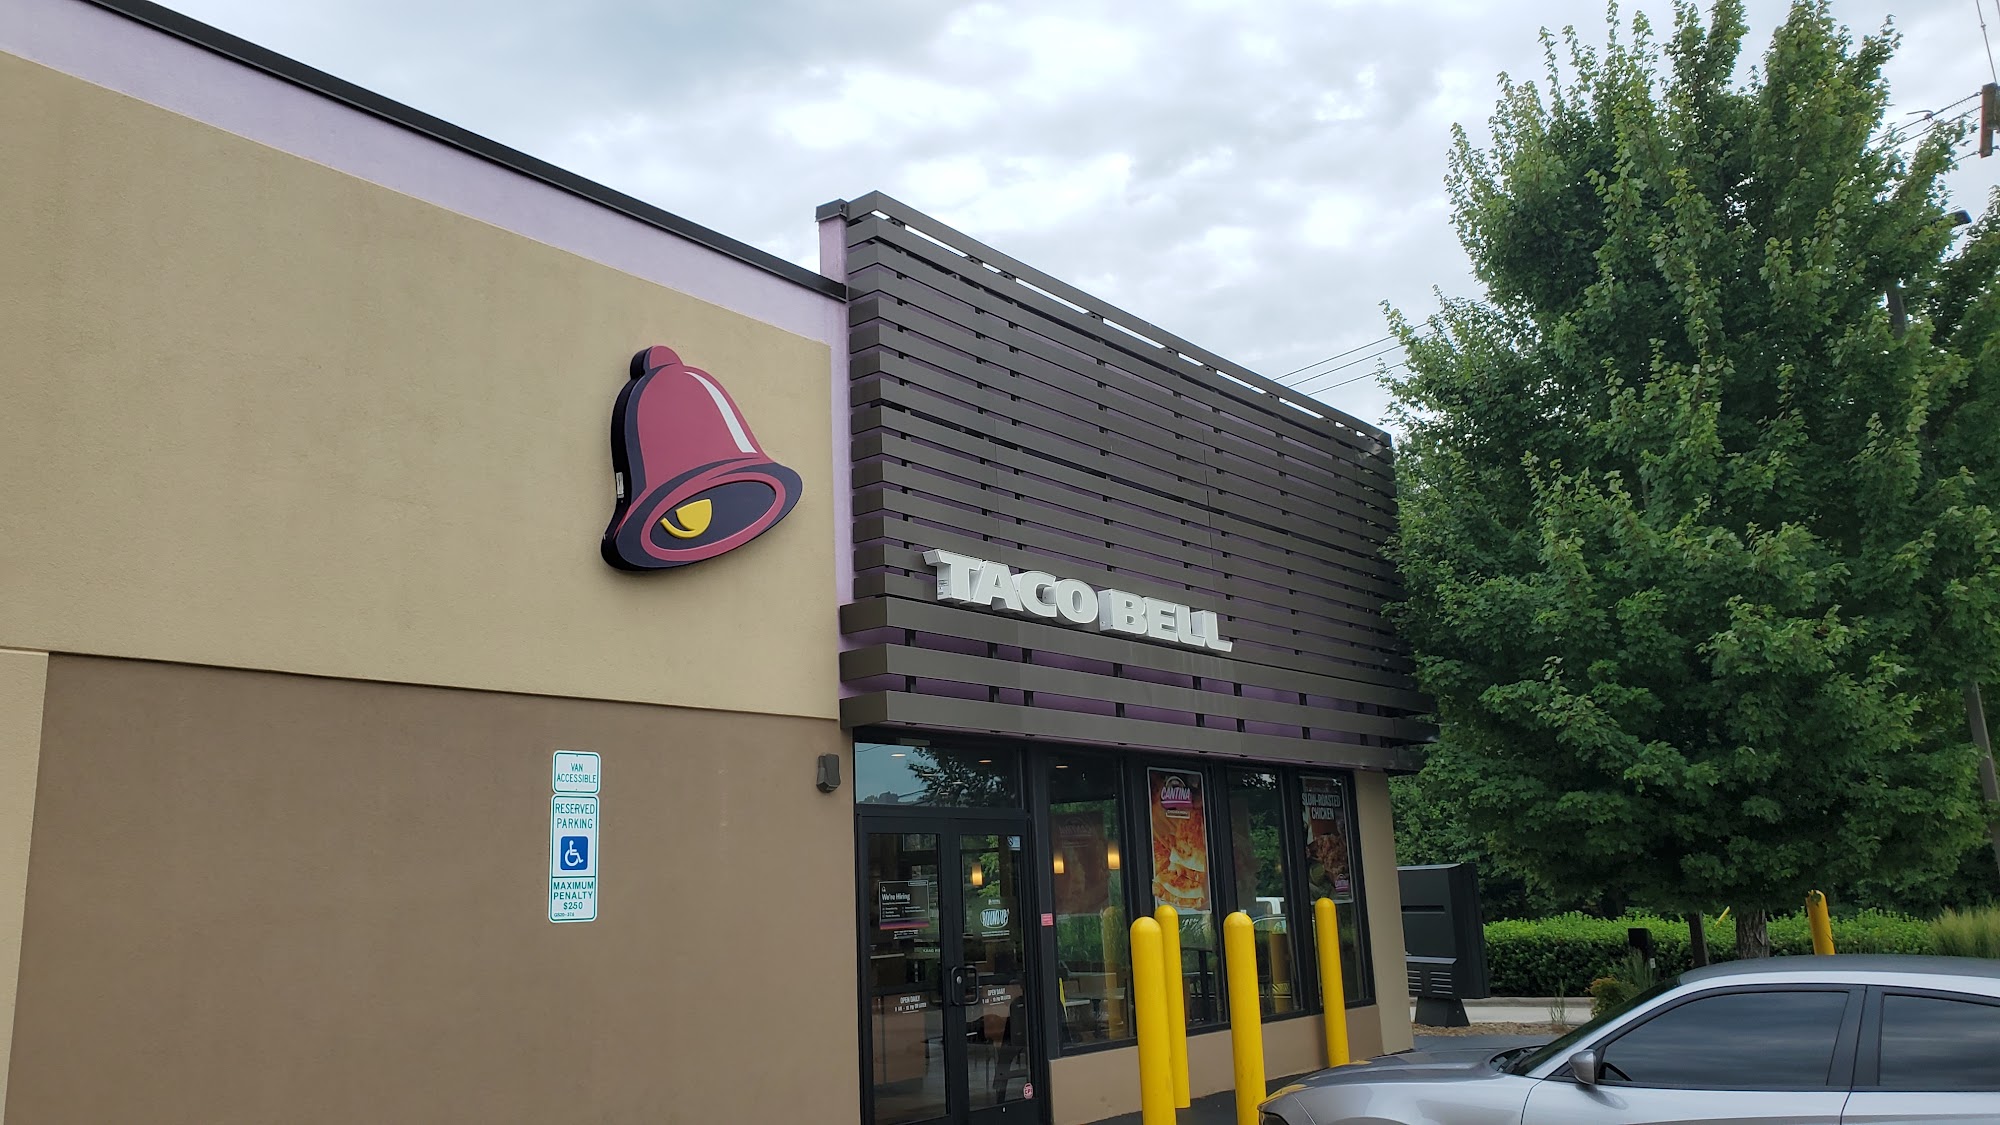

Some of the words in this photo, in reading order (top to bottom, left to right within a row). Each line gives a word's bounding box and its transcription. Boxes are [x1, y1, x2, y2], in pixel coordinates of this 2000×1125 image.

[922, 548, 1098, 625] TACO
[1098, 588, 1233, 653] BELL
[570, 762, 584, 772] VAN
[556, 773, 597, 783] ACCESSIBLE
[1161, 786, 1191, 800] CANTINA
[1301, 792, 1341, 807] SLOW-ROASTED
[555, 803, 595, 815] RESERVED
[1311, 807, 1335, 820] CHICKEN
[556, 817, 593, 829] PARKING
[553, 881, 594, 890] MAXIMUM
[553, 891, 593, 900] PENALTY
[881, 893, 895, 901] We're
[895, 892, 911, 901] Hiring
[563, 901, 583, 910] $250
